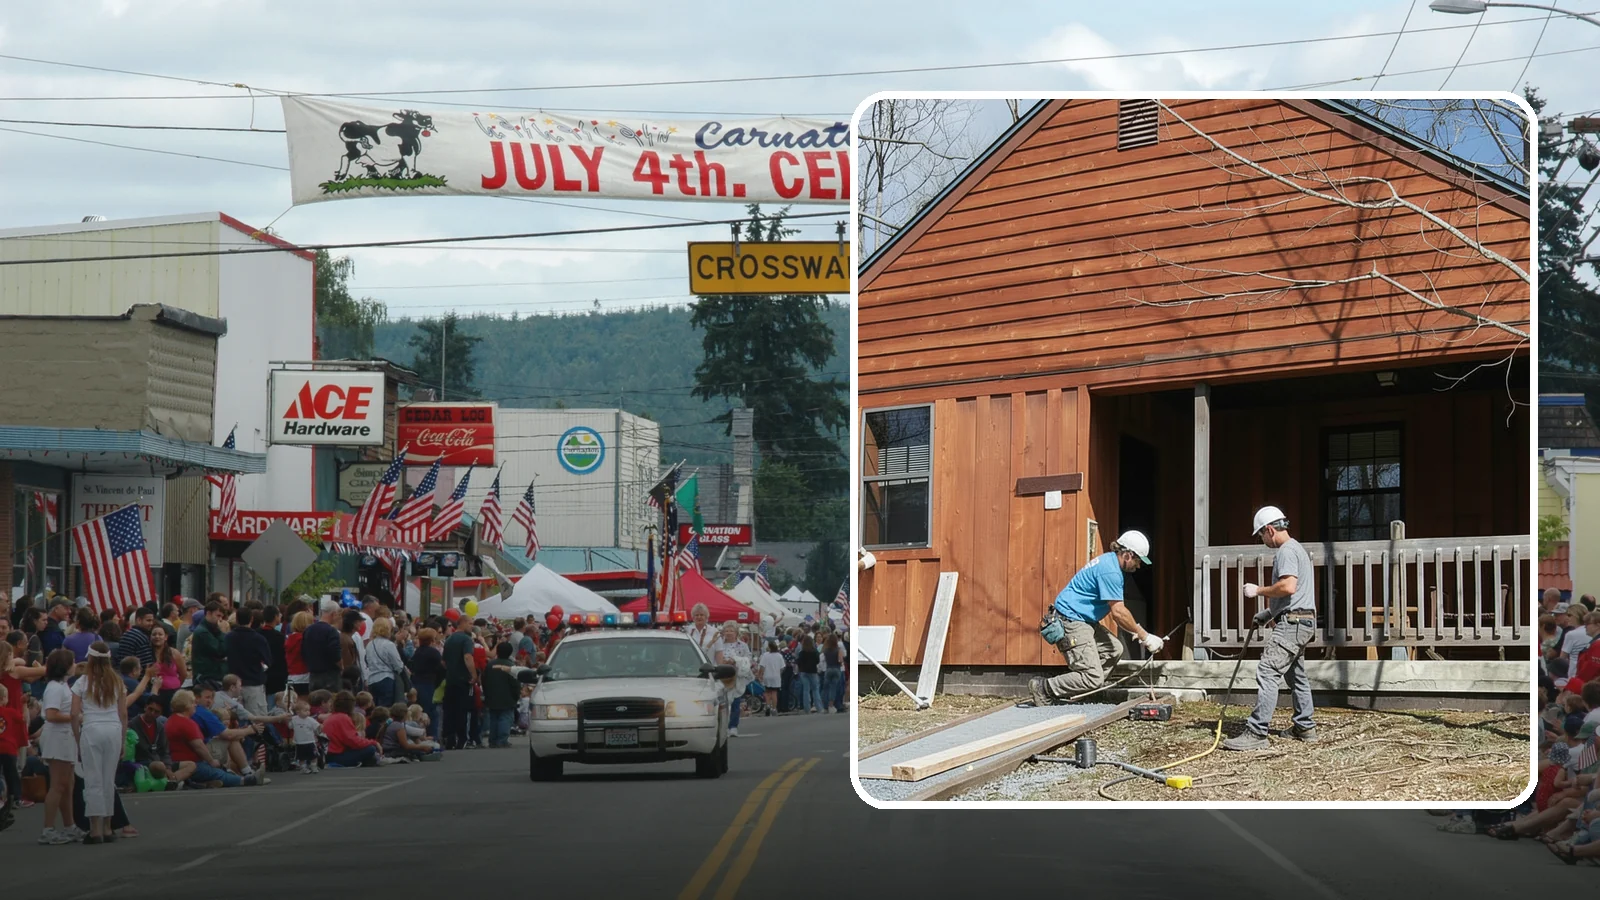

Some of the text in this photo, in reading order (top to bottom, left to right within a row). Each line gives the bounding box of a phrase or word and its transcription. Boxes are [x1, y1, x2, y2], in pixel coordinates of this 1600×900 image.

[695, 121, 850, 149] Carnat
[481, 141, 605, 193] JULY
[632, 150, 746, 198] 4th.
[696, 254, 850, 280] CROSSWA
[282, 380, 374, 420] ACE
[406, 409, 485, 422] CEDAR LOG
[283, 421, 371, 436] Hardware
[95, 485, 124, 495] Vincent
[126, 486, 136, 495] de
[137, 486, 155, 495] Paul
[688, 526, 741, 535] CRNATION
[699, 535, 730, 543] GLASS
